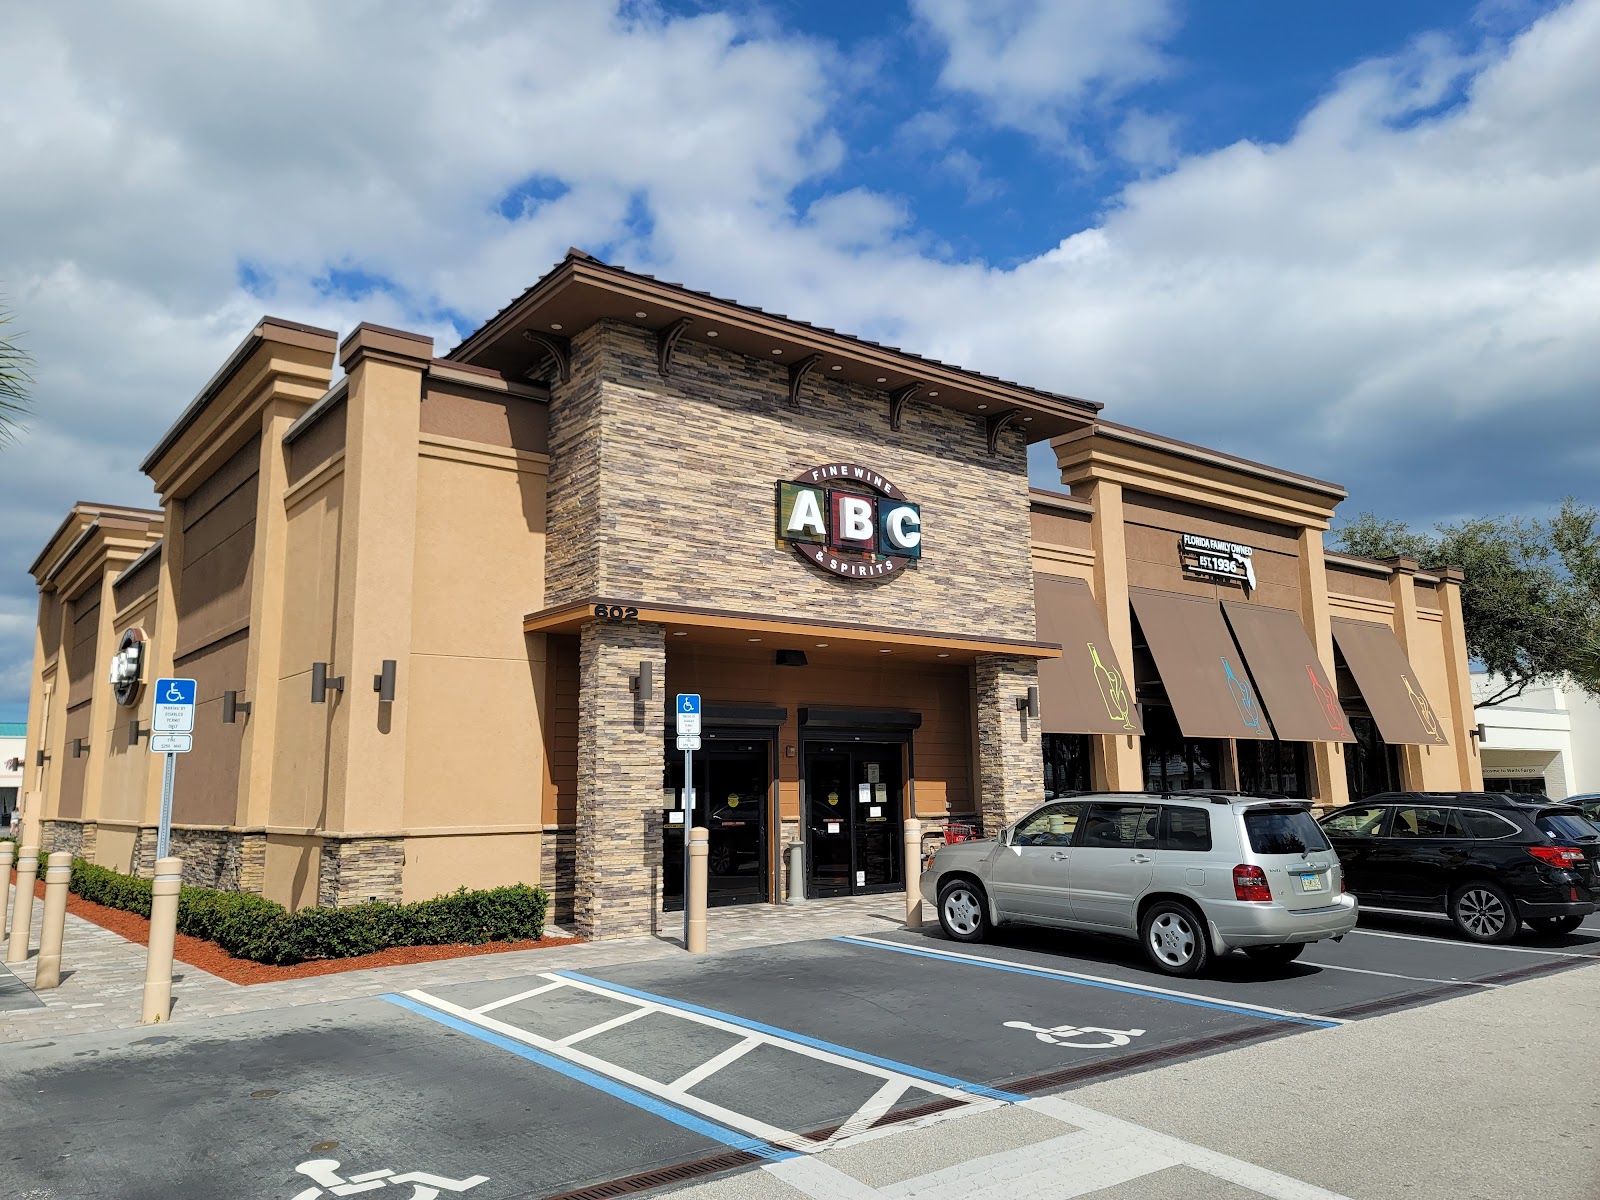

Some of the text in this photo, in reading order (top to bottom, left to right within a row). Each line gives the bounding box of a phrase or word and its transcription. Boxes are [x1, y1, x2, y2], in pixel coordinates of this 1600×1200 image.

[812, 465, 892, 494] FINE WINE
[787, 489, 921, 549] ABC
[1183, 534, 1253, 556] FLORIDA FAMILY OWNED
[816, 551, 893, 576] & SPIRITS
[1212, 557, 1237, 573] 1936
[594, 604, 638, 621] 602
